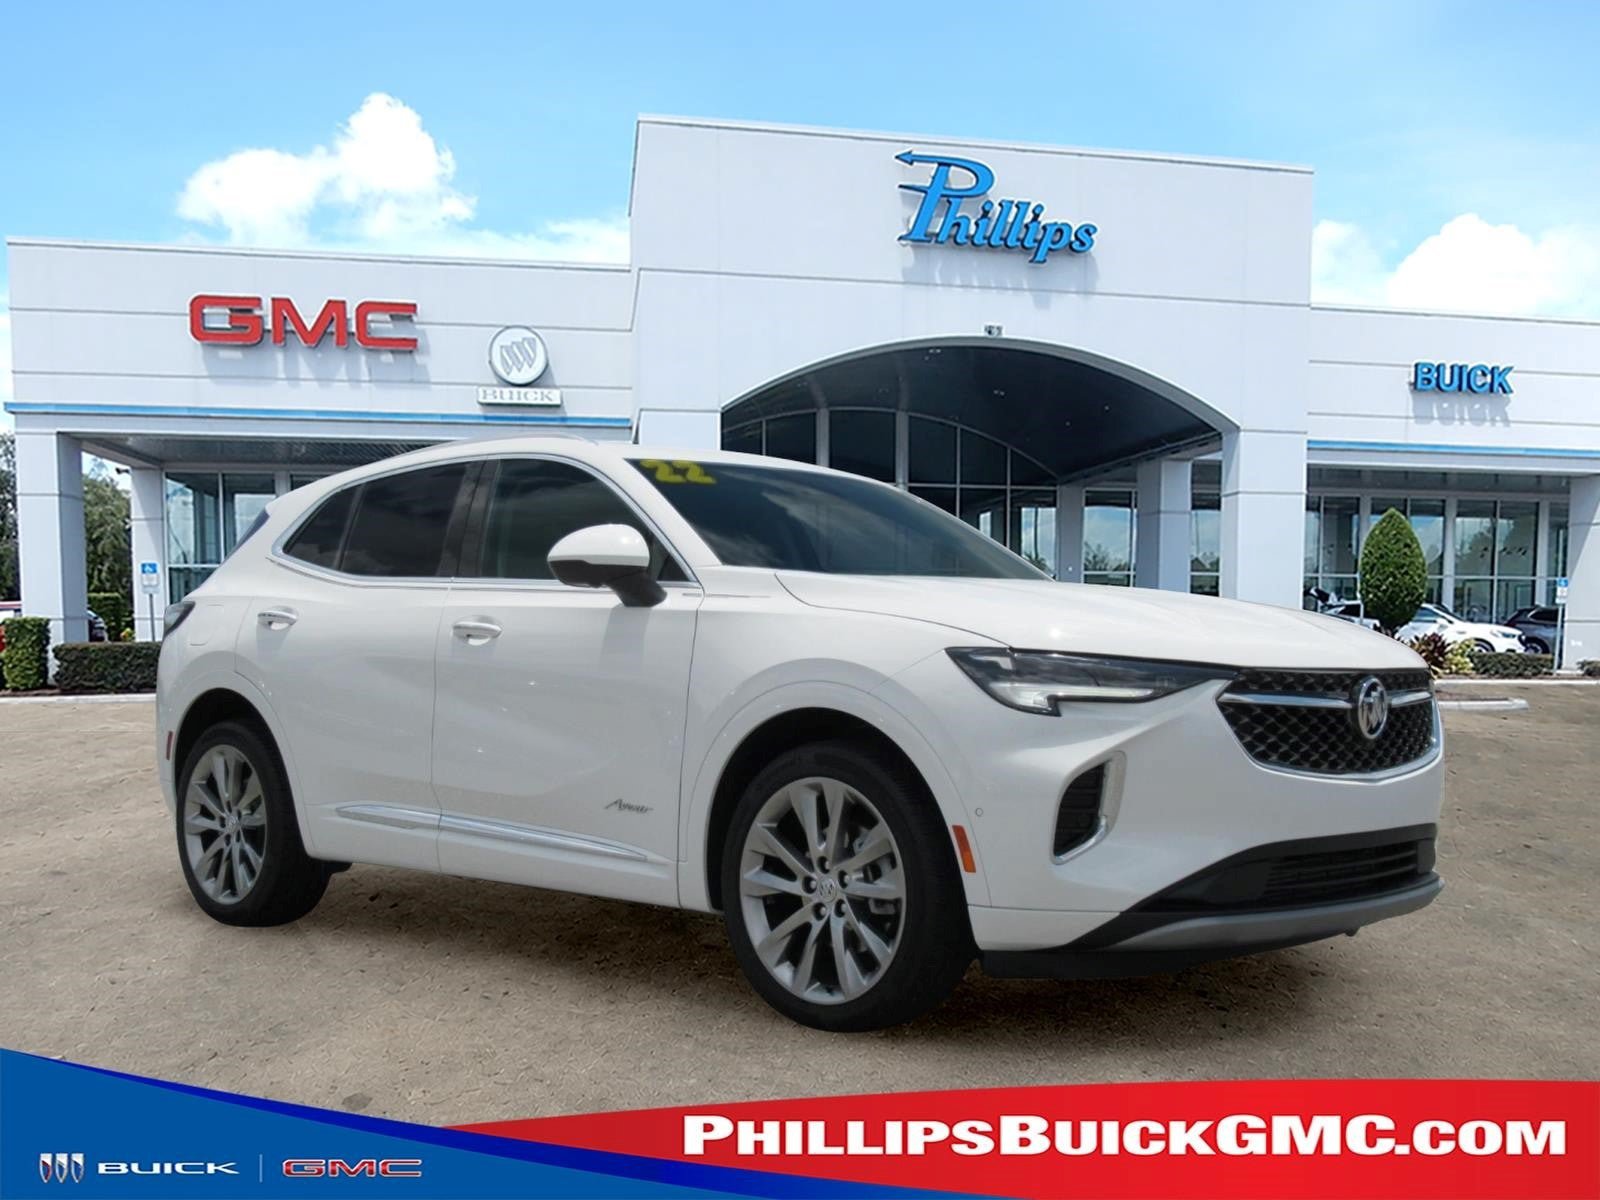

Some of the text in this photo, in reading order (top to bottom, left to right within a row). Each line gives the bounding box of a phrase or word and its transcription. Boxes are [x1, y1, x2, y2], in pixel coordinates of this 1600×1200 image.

[895, 150, 1098, 263] Phillips
[189, 294, 418, 351] GMC
[1414, 362, 1514, 394] BUICK
[482, 389, 554, 402] BUICK
[640, 459, 716, 484] 22
